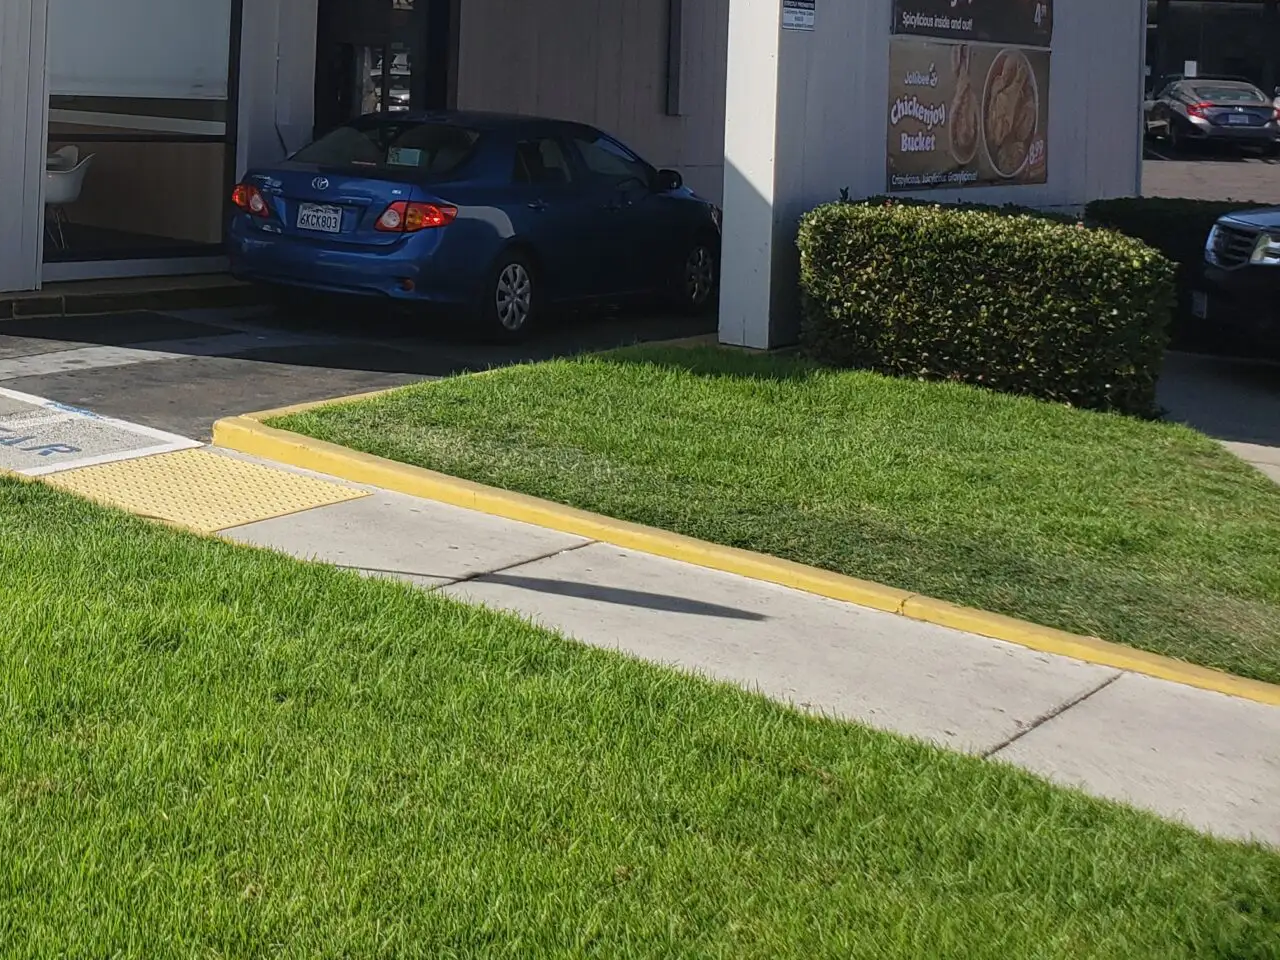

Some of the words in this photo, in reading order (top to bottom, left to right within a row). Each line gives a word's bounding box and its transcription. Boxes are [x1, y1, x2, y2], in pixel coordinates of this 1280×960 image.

[902, 11, 933, 29] Spicylicious
[934, 14, 950, 28] inside
[951, 17, 961, 30] and
[890, 96, 945, 129] Chickenjoy
[901, 132, 936, 151] Bucket
